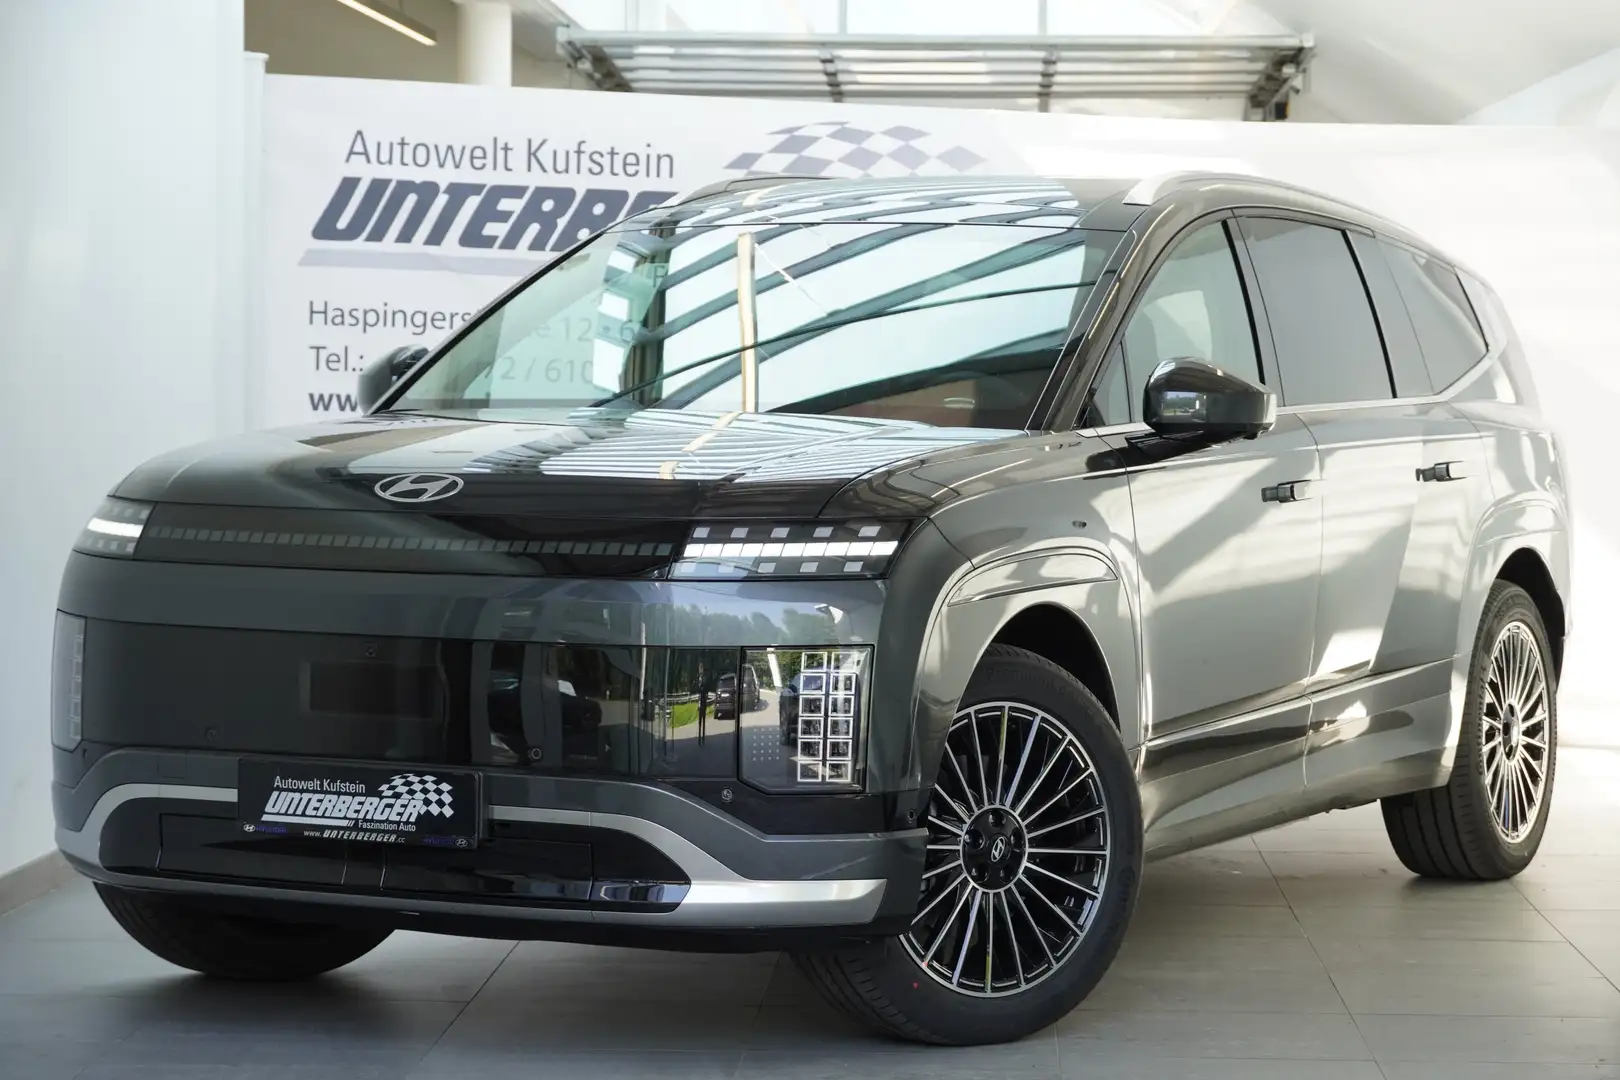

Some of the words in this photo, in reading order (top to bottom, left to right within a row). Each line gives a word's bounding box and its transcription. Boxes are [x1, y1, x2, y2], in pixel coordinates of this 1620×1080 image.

[344, 129, 514, 172] Autowelt
[526, 137, 675, 179] Kufstein
[309, 345, 363, 372] Tel.:
[274, 775, 321, 791] Autowelt
[323, 779, 366, 794] Kufstein
[264, 790, 424, 823] UNTERBERGER
[358, 820, 398, 831] Faszination
[398, 822, 416, 832] Auto
